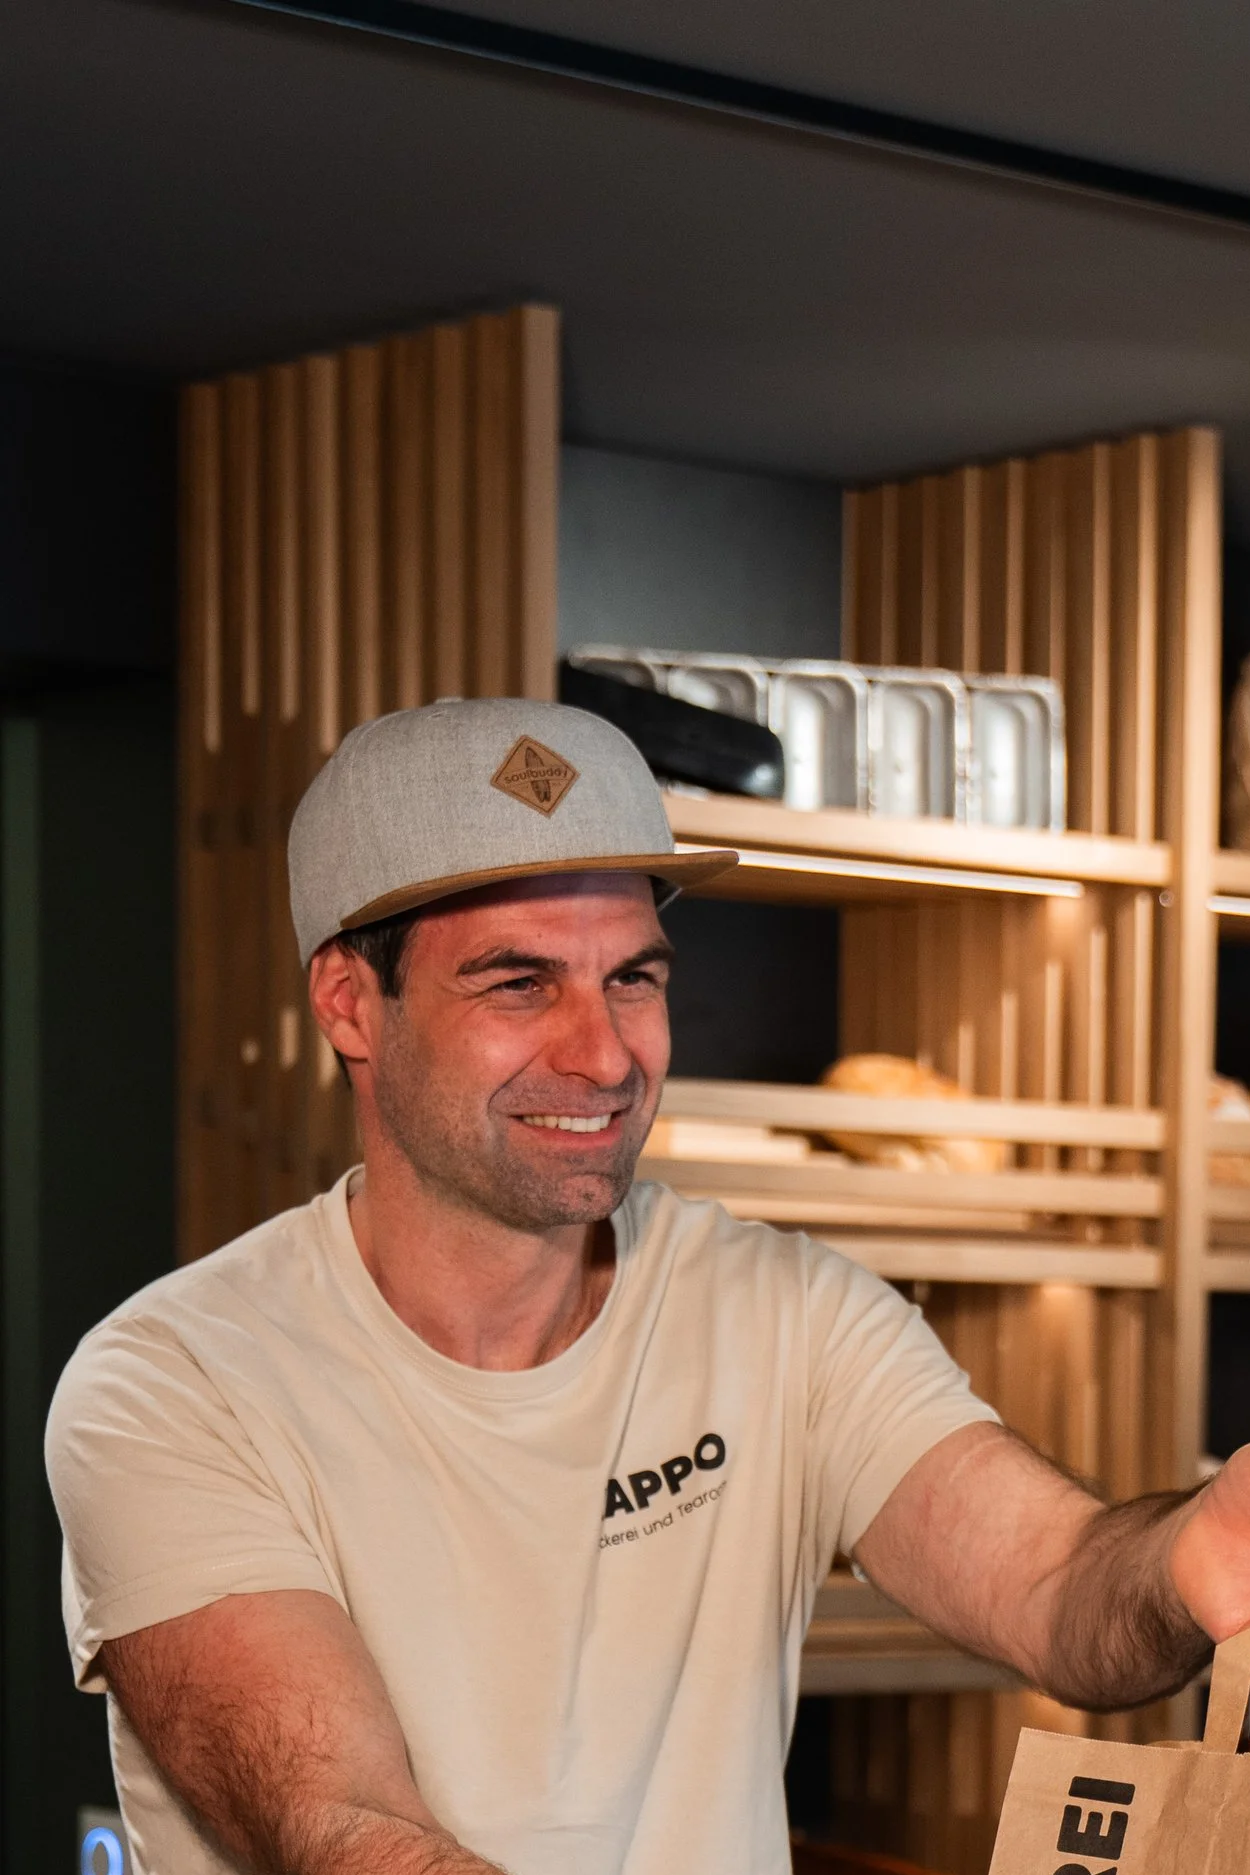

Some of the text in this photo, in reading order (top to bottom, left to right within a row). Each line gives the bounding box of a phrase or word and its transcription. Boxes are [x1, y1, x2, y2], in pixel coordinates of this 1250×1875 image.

[601, 1433, 726, 1522] APPO
[642, 1511, 674, 1537] und
[677, 1479, 728, 1517] Tearo
